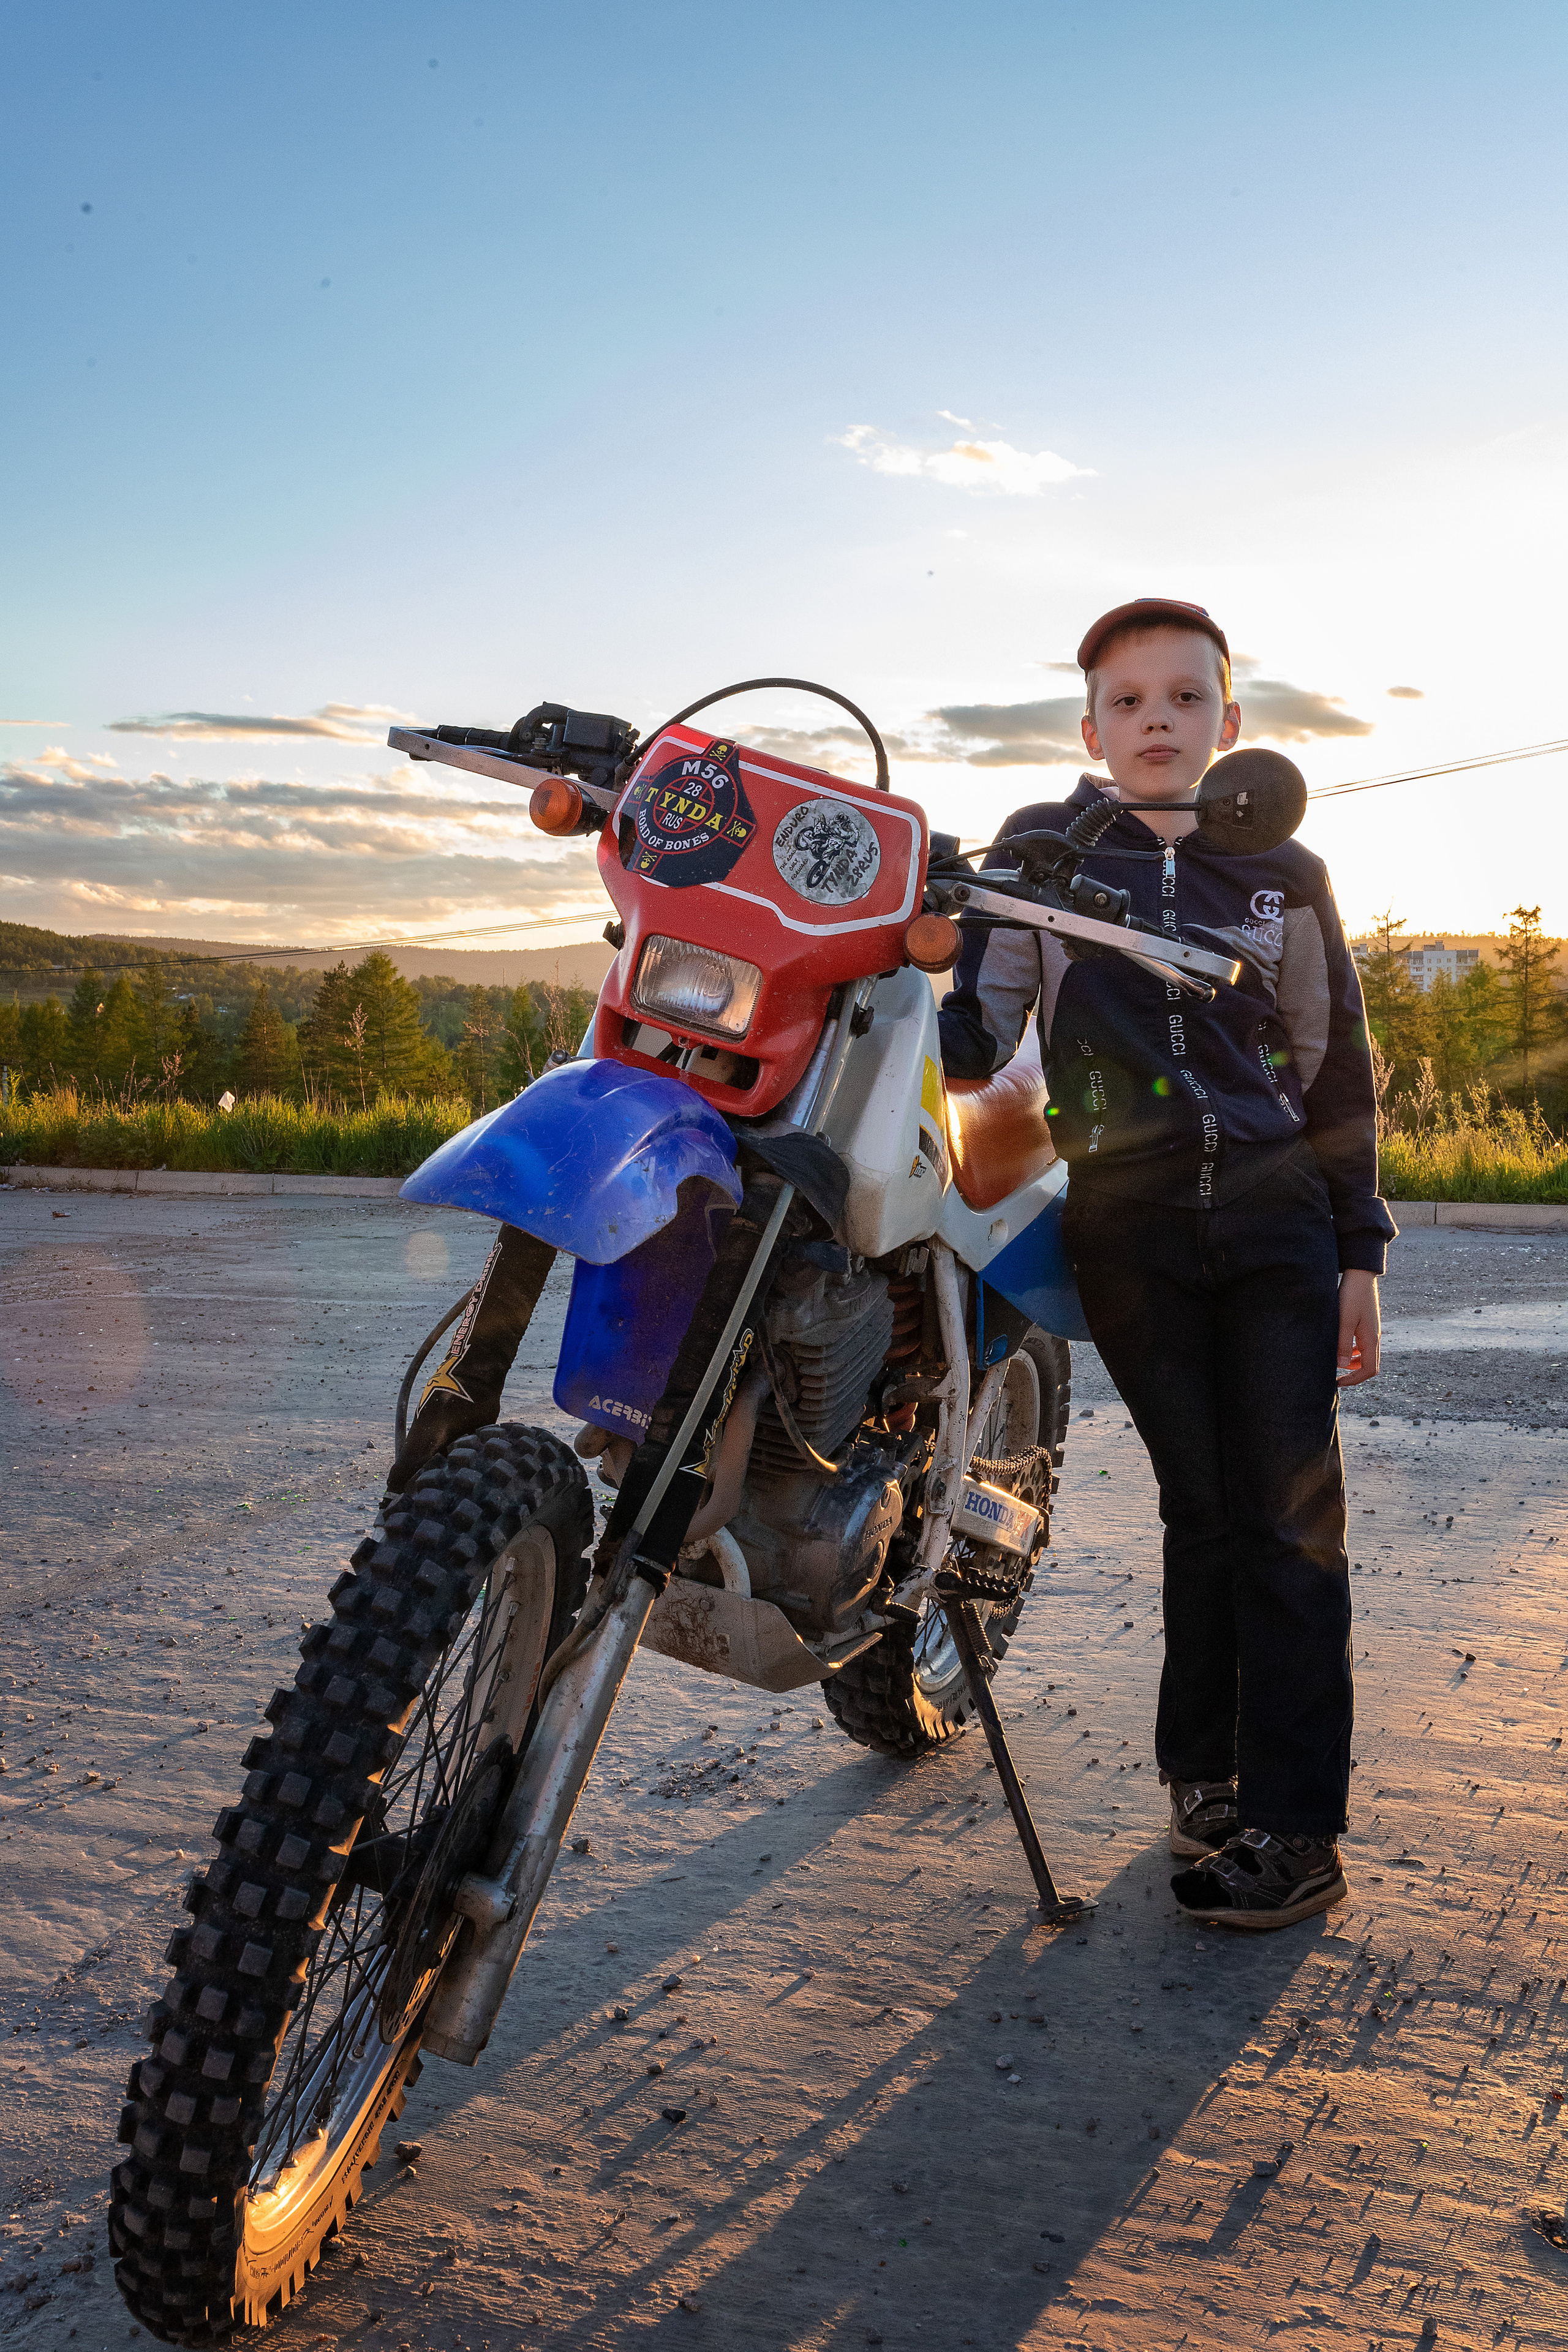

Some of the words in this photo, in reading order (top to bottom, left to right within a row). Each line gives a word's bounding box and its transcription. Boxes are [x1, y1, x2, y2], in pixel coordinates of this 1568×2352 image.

[681, 760, 729, 789] M56
[684, 782, 703, 797] 28
[645, 786, 723, 831] TYNDA
[662, 813, 683, 829] RUS
[775, 806, 809, 848] ENDURO
[639, 809, 650, 839] ROAD
[648, 835, 663, 848] OF
[664, 832, 709, 850] BONES
[779, 862, 788, 870] THE
[786, 850, 796, 862] ROAD
[789, 858, 798, 871] ONLY
[791, 858, 809, 881] FORWARD
[821, 848, 858, 893] TYNDA
[846, 842, 878, 887] 28RUS
[1162, 859, 1175, 897] CCI
[1242, 927, 1283, 948] GUCC
[1245, 918, 1265, 926] GUCCI
[1169, 1015, 1186, 1055] GUCCI
[1258, 1044, 1278, 1083] GUCCI
[1090, 1071, 1107, 1110] GUCCI
[1180, 1069, 1208, 1099] GUCCI
[1202, 1114, 1218, 1152] GUCCI
[1199, 1163, 1214, 1196] GUCCI
[451, 1295, 478, 1355] ENERGY
[965, 1491, 1015, 1529] HONDA
